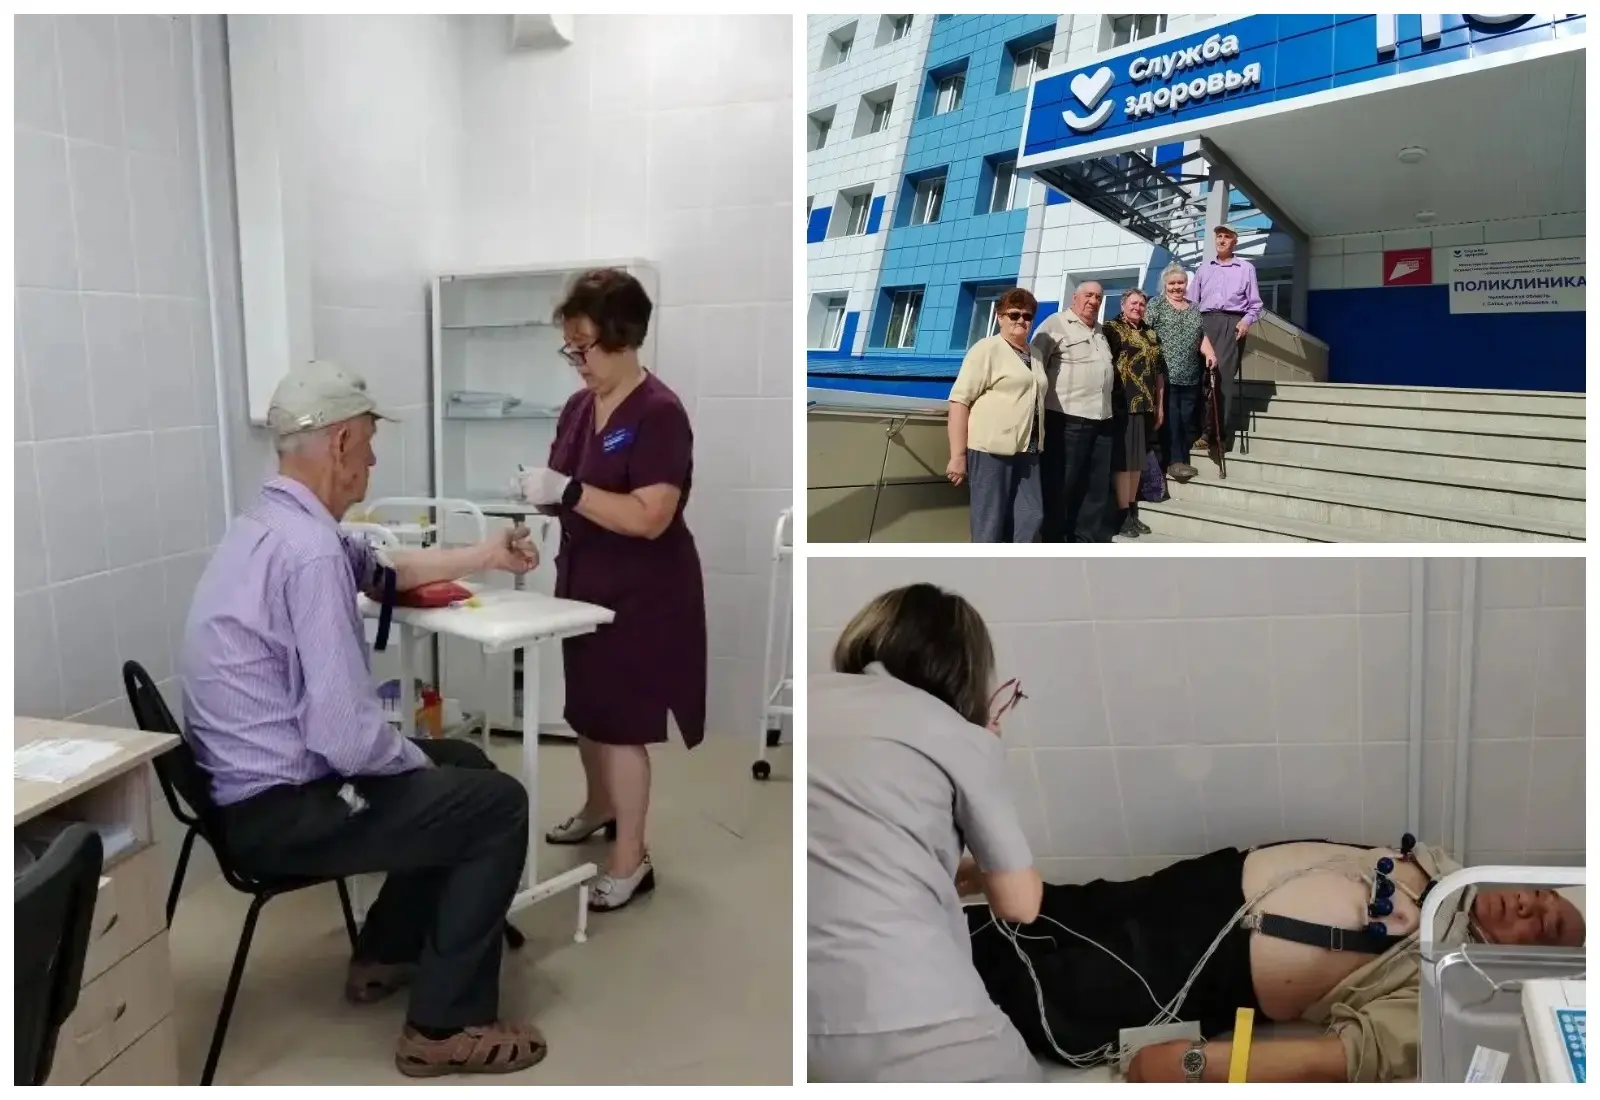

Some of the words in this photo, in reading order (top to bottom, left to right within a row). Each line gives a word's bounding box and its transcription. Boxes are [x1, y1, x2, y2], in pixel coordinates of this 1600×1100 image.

[1129, 33, 1239, 81] Служба
[1123, 62, 1261, 117] здоровья
[1453, 275, 1586, 292] ПОЛИКЛИНИКА
